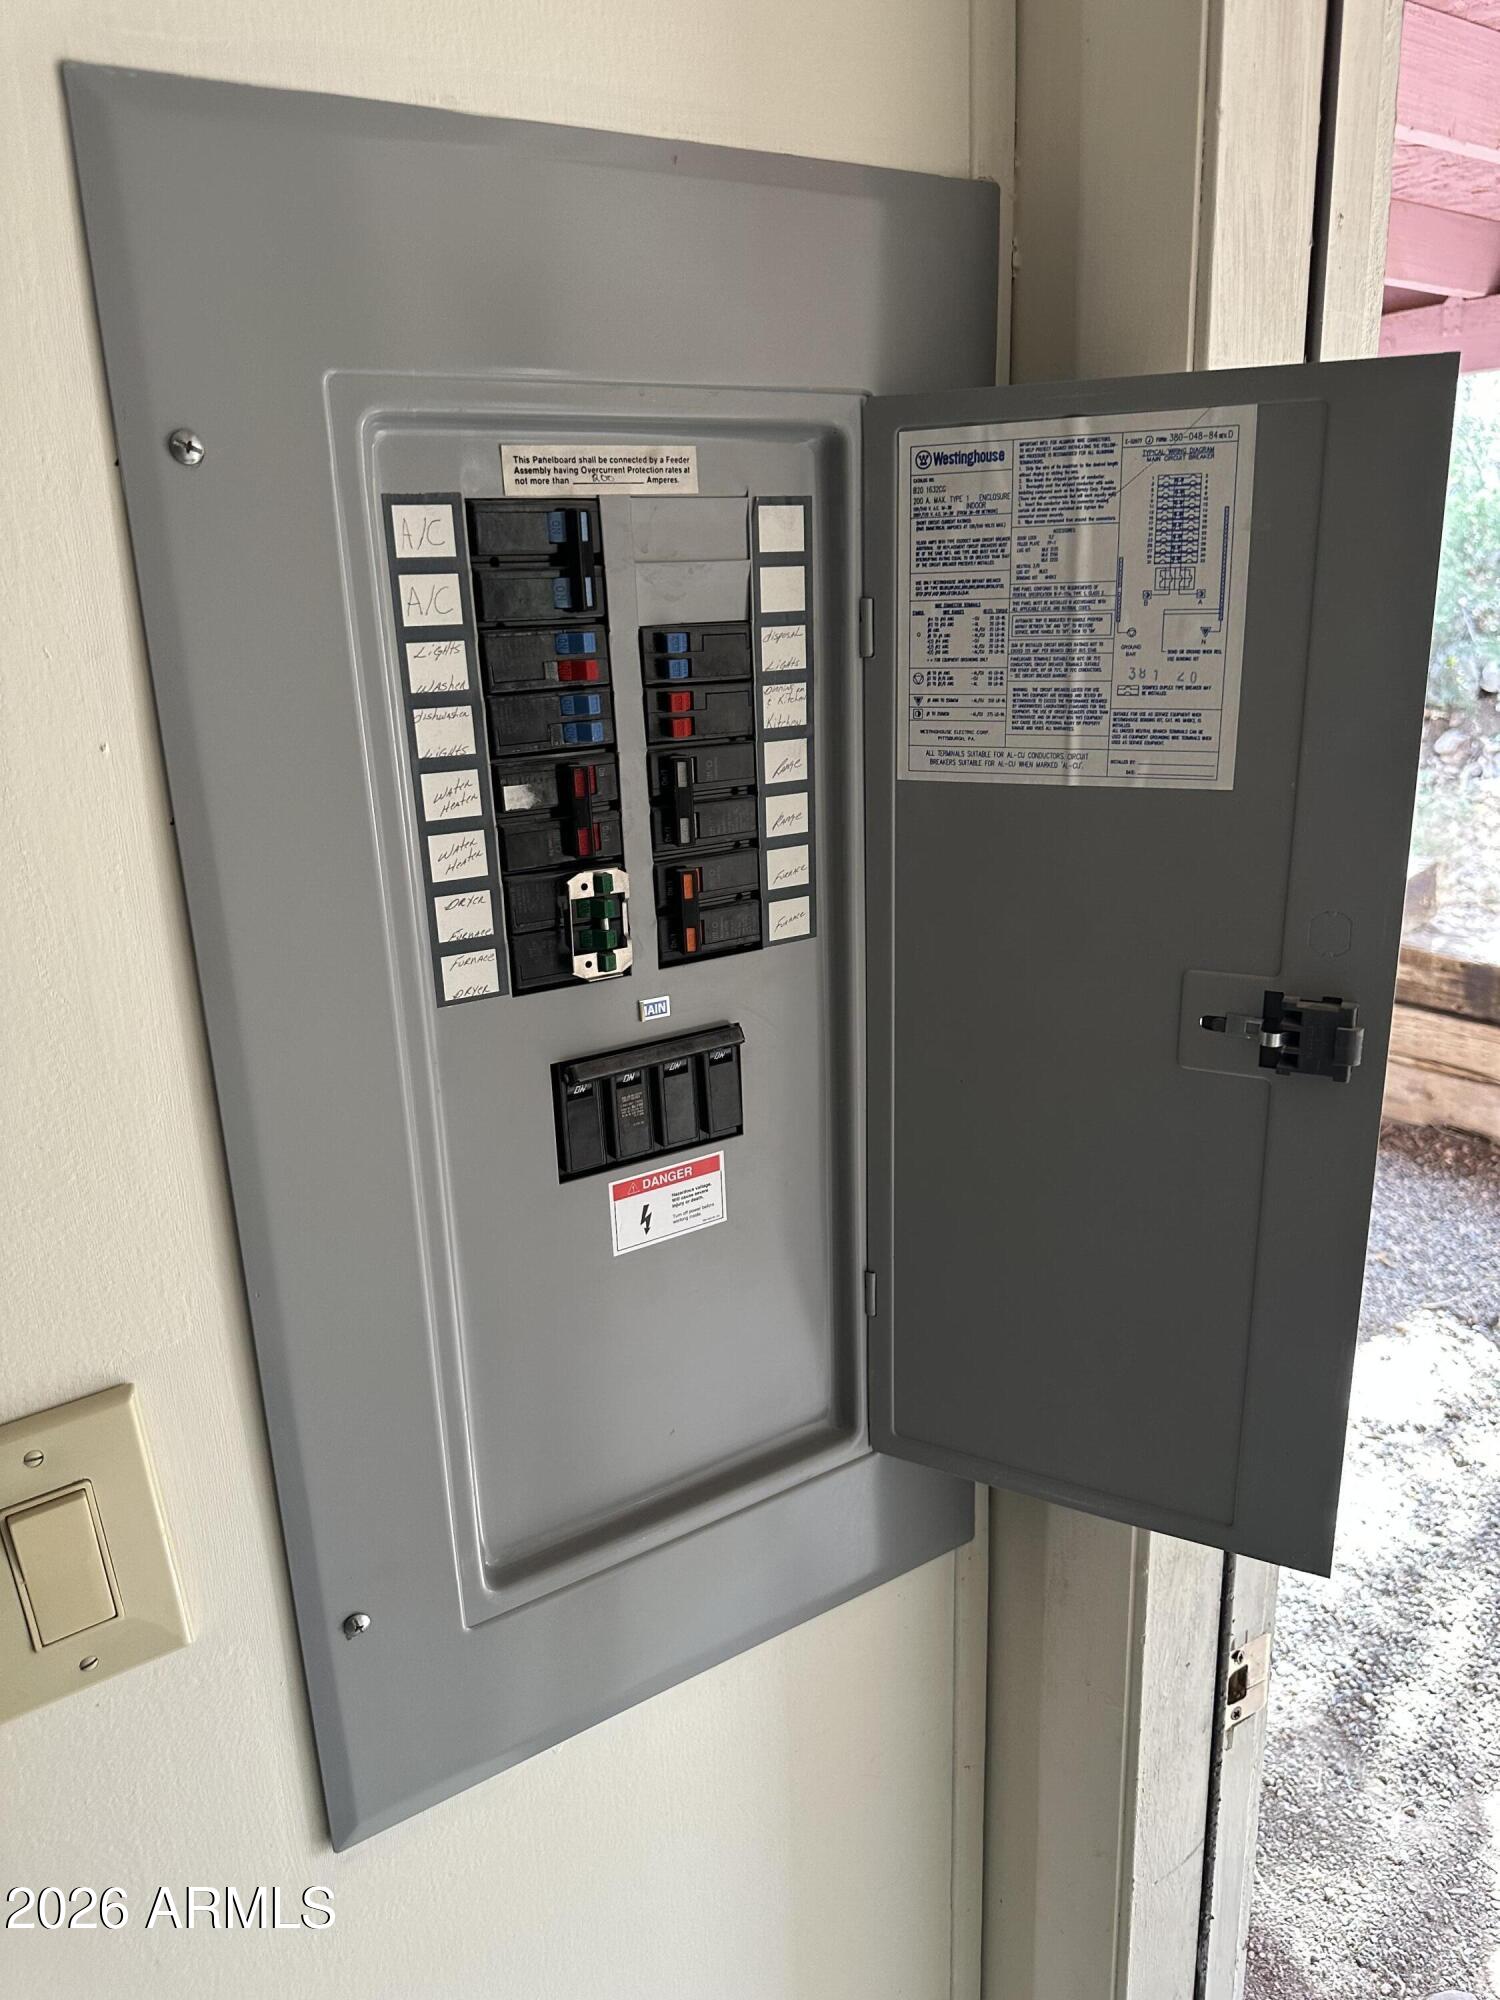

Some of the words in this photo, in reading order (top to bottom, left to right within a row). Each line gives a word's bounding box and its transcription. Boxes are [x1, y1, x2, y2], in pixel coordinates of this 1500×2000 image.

[1169, 431, 1218, 442] 380-048-84
[1142, 449, 1165, 457] TYPICAL
[1168, 448, 1187, 456] WIRING
[1189, 446, 1215, 455] DIAGRAM
[513, 456, 530, 464] This
[533, 456, 576, 464] Panelboard
[579, 456, 596, 464] shall
[598, 456, 607, 464] be
[610, 456, 647, 464] connected
[650, 456, 658, 465] by
[666, 456, 689, 464] Feeder
[933, 449, 1005, 466] Westinghouse
[514, 466, 551, 475] Assembly
[554, 467, 578, 476] having
[581, 466, 625, 474] Overcurrent
[627, 466, 663, 474] Protection
[665, 466, 682, 474] rates
[515, 477, 527, 485] not
[552, 477, 569, 485] than
[647, 476, 679, 485] Amperes.
[979, 492, 1010, 501] ENCLOSURE
[402, 517, 446, 550] A/C
[407, 584, 453, 617] A/C
[1007, 751, 1025, 759] AL-CU
[1067, 753, 1088, 761] CIRCUIT
[669, 1061, 681, 1071] ON
[623, 1073, 635, 1082] ON
[574, 1085, 586, 1094] ON
[642, 1166, 693, 1189] DANGER
